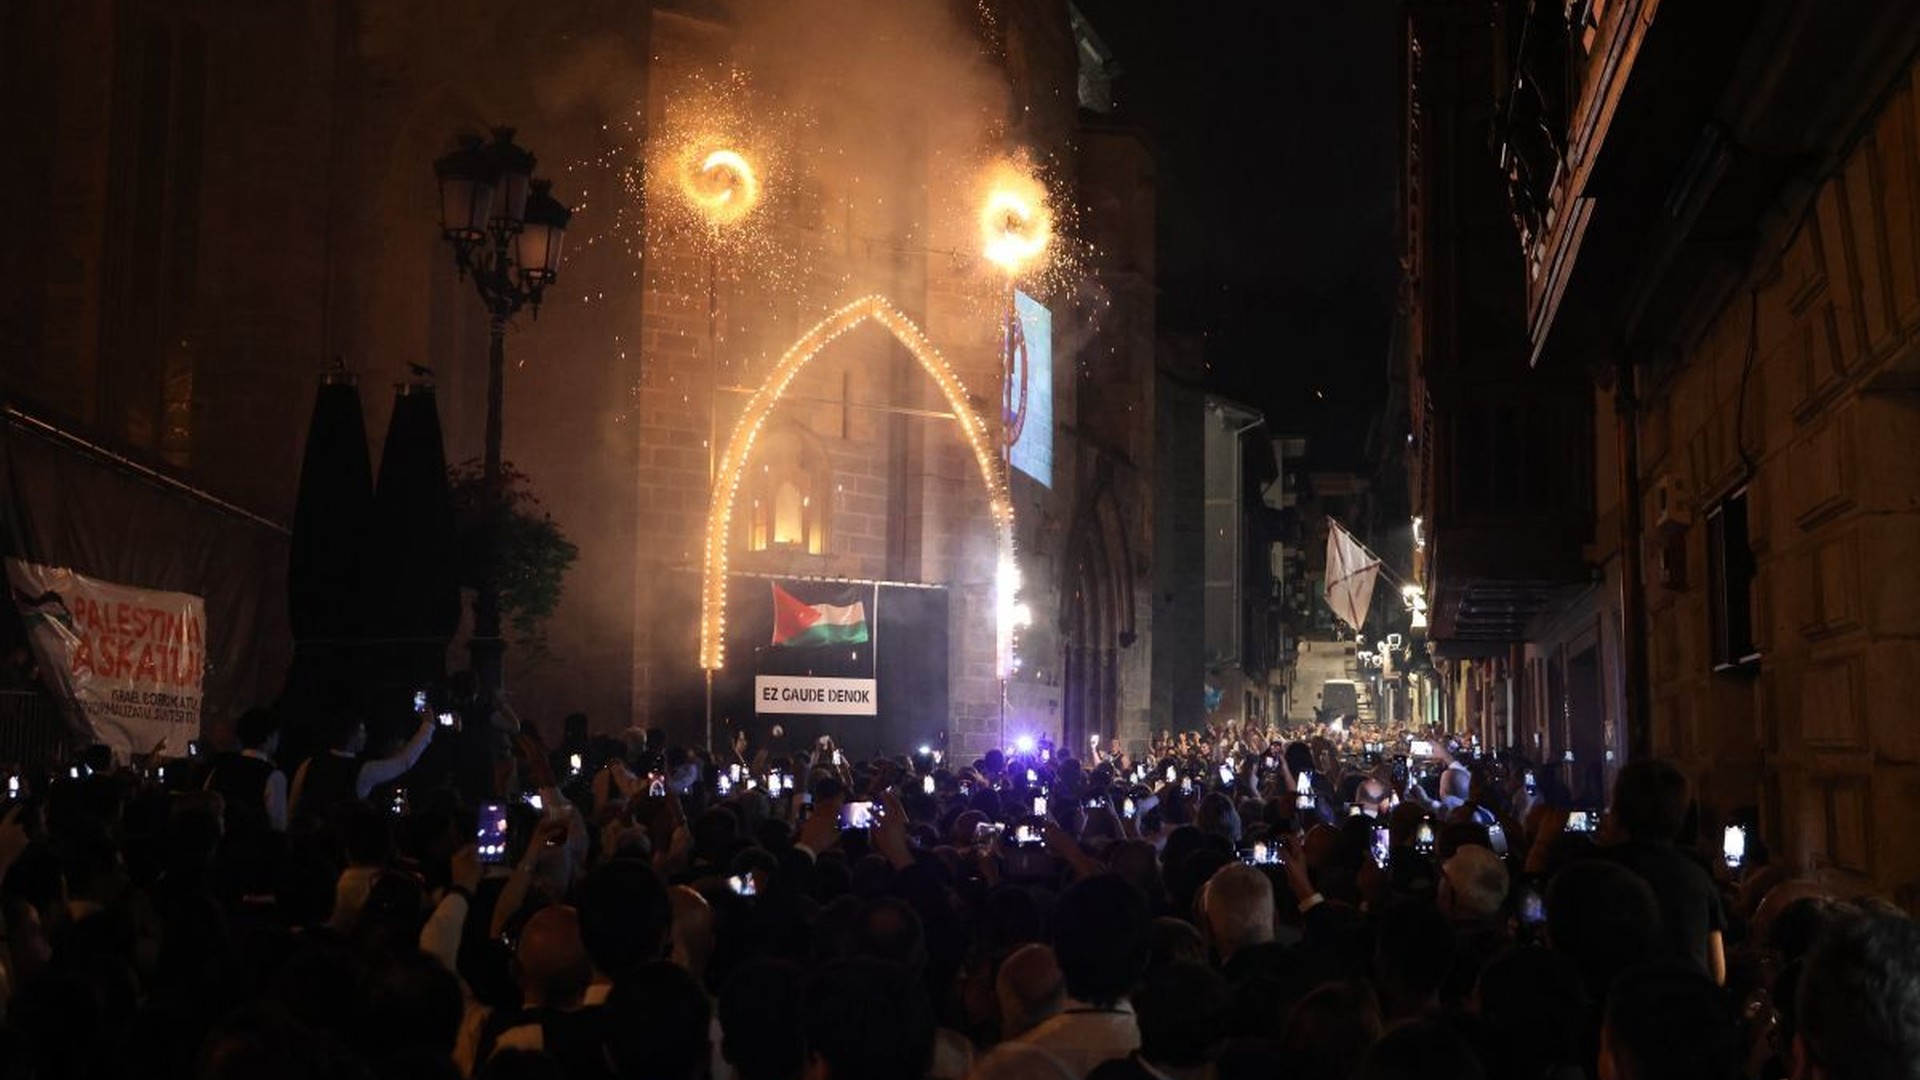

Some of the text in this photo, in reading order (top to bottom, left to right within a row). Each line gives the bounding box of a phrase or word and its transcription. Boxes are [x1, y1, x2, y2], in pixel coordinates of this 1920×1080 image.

[73, 597, 201, 643] PALESTINA
[763, 687, 870, 703] EZ GAUDE DENOK
